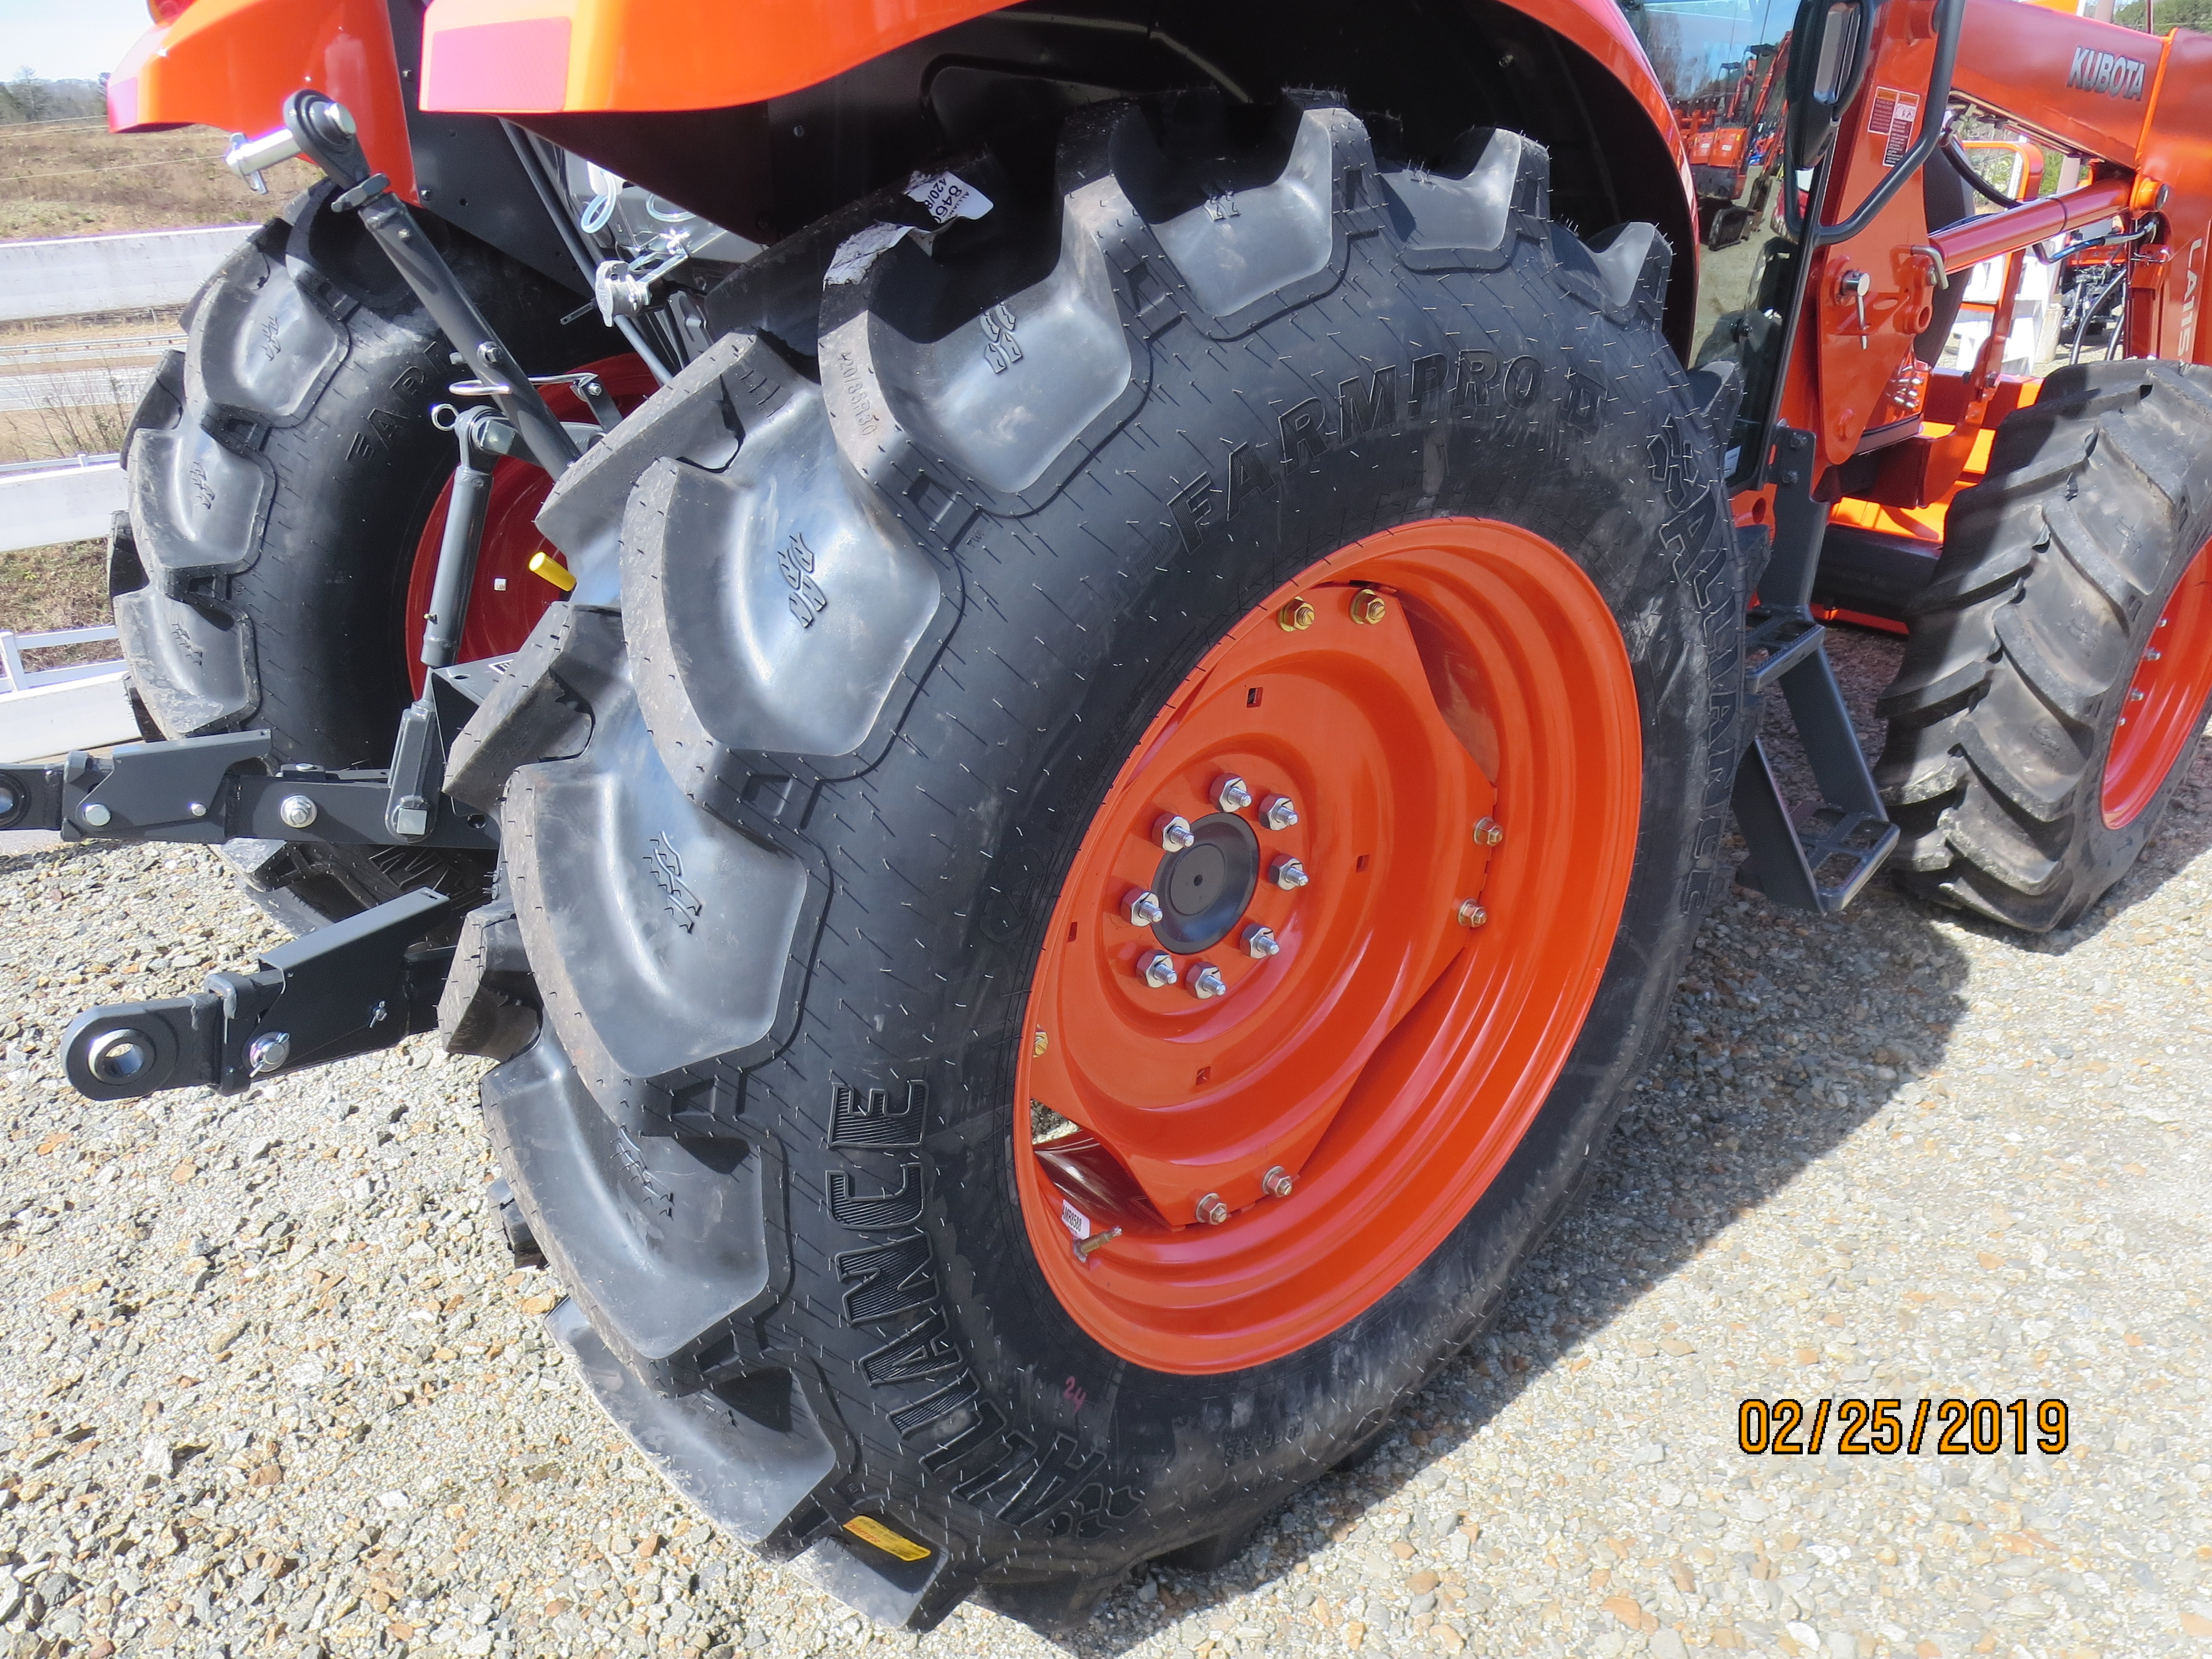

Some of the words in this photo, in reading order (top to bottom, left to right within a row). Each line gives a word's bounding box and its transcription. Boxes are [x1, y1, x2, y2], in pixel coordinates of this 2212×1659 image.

[2066, 46, 2146, 101] KUBOTA
[2177, 238, 2203, 365] LA115
[1166, 348, 1543, 554] FARMPRO
[1660, 480, 1737, 915] ALLIANCE
[825, 1079, 1107, 1527] ALLIANCE
[1063, 1375, 1087, 1413] 24
